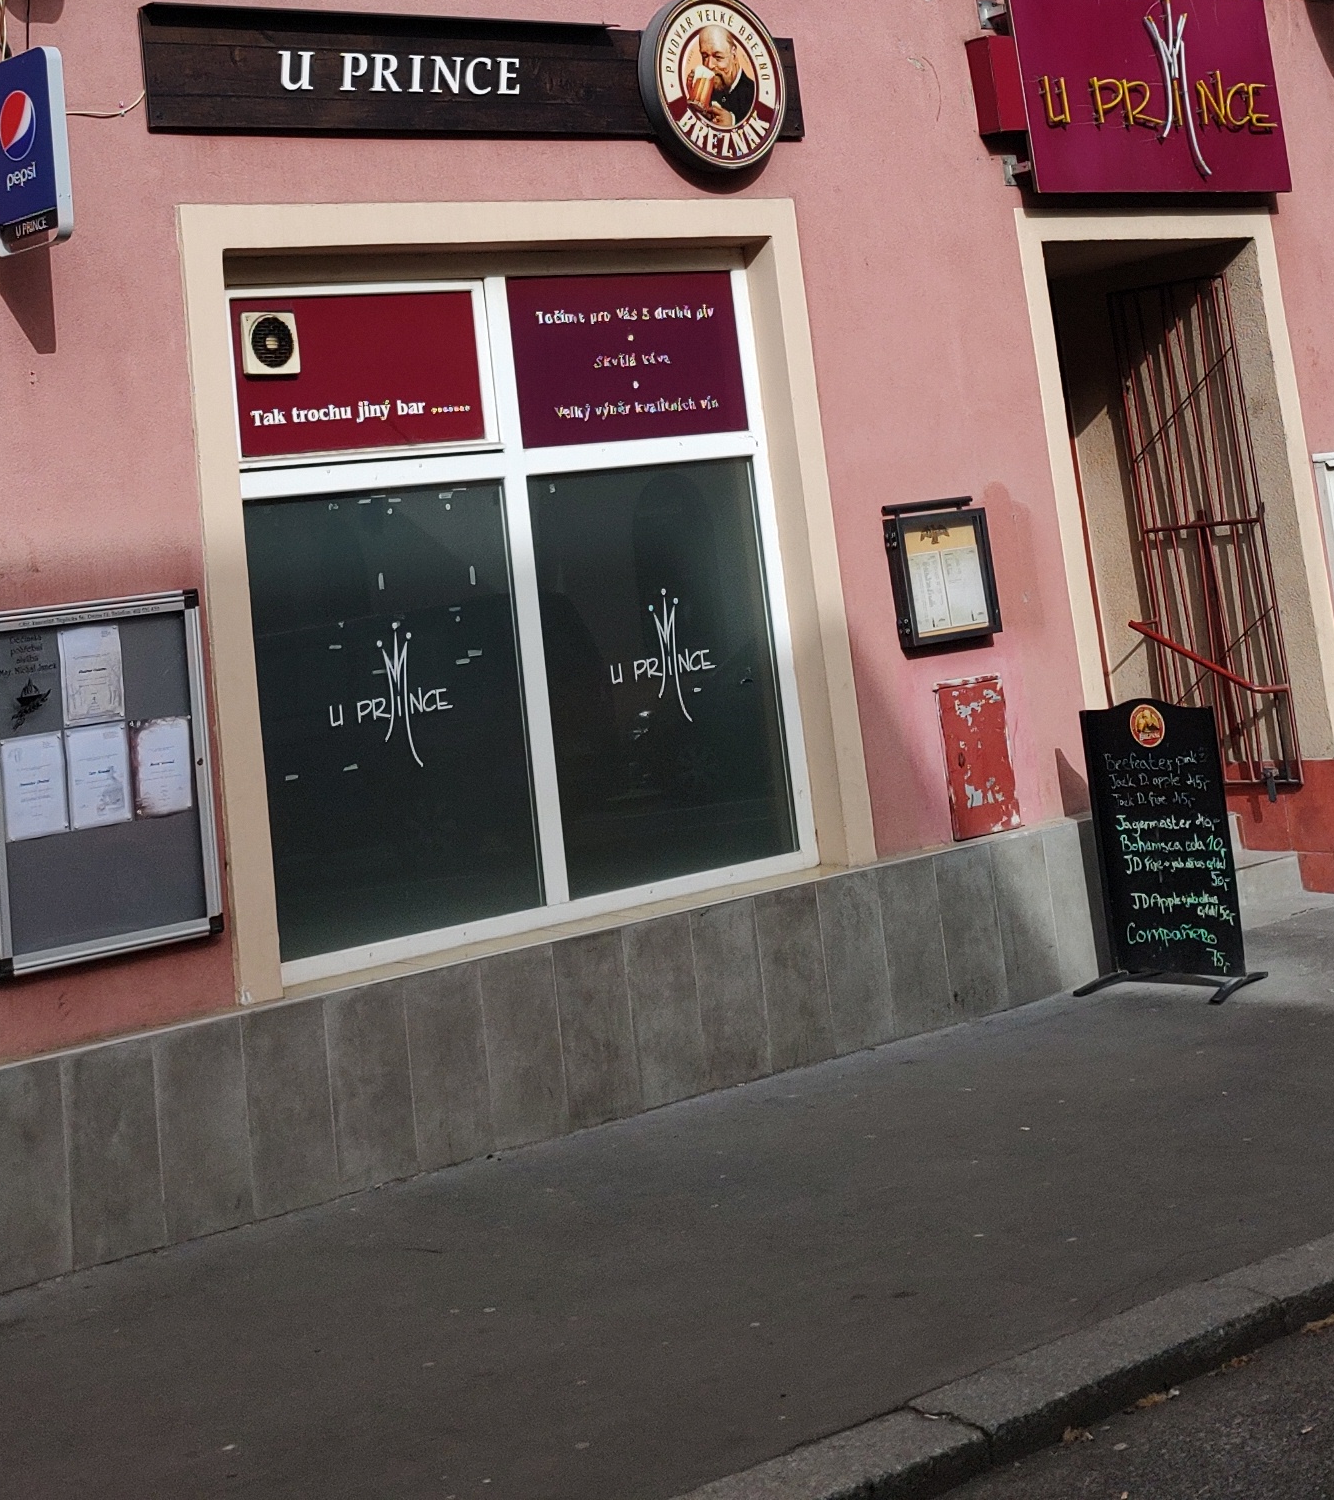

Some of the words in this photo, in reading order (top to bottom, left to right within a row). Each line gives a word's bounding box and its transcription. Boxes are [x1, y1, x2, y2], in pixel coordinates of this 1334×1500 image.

[666, 17, 694, 73] PIVOVAR
[696, 9, 734, 28] VELKÉ
[738, 24, 771, 81] BŘEZNO
[277, 50, 315, 91] U
[339, 52, 520, 95] PRINCE
[1042, 74, 1071, 124] U
[1089, 70, 1278, 127] PRINCE
[677, 108, 770, 158] BŘEZŇÁK
[6, 161, 37, 191] pepsi
[22, 215, 49, 236] PRINCE
[590, 311, 611, 325] pro
[251, 409, 287, 427] Tak
[292, 404, 353, 423] trochu
[356, 399, 391, 423] jiný
[397, 400, 426, 416] bar
[610, 662, 624, 684] U
[633, 648, 717, 682] PRINCE
[329, 704, 344, 727] U
[357, 687, 454, 723] PRINCE
